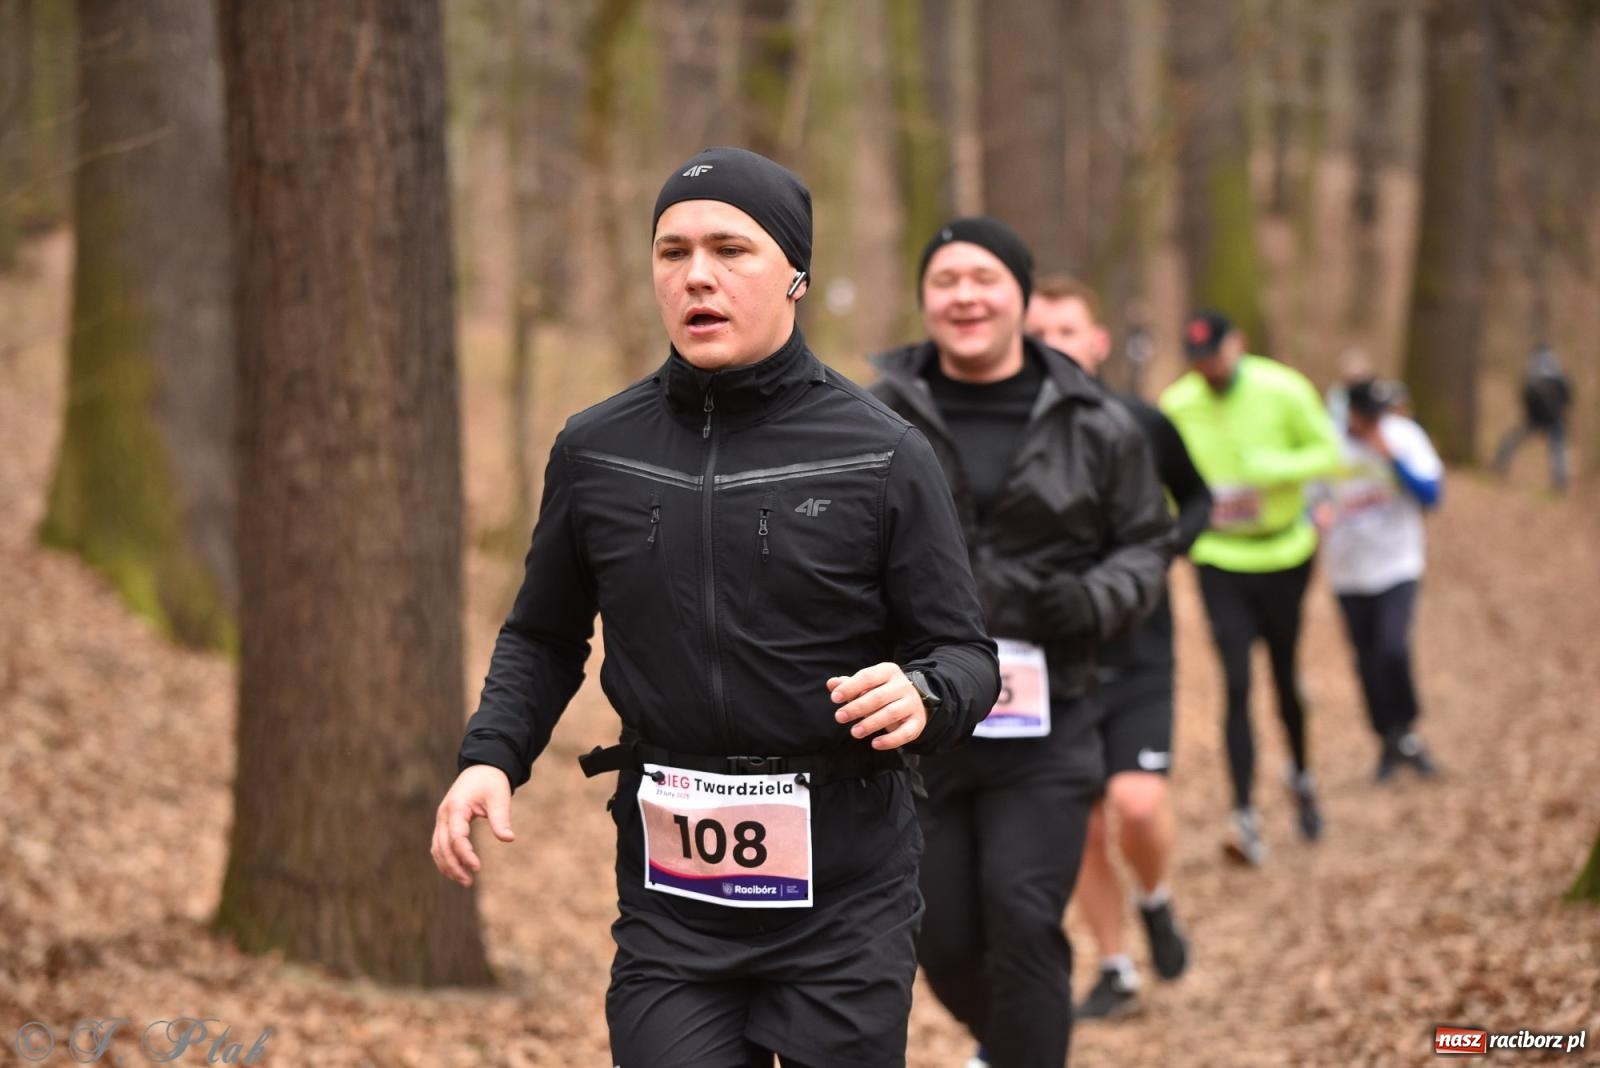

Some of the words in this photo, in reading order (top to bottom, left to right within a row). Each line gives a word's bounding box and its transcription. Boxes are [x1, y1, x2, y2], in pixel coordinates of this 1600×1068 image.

[682, 165, 713, 177] 4F
[795, 498, 831, 516] 4F
[694, 778, 793, 796] Twardziela
[673, 814, 767, 868] 108
[734, 885, 777, 894] Racibórz
